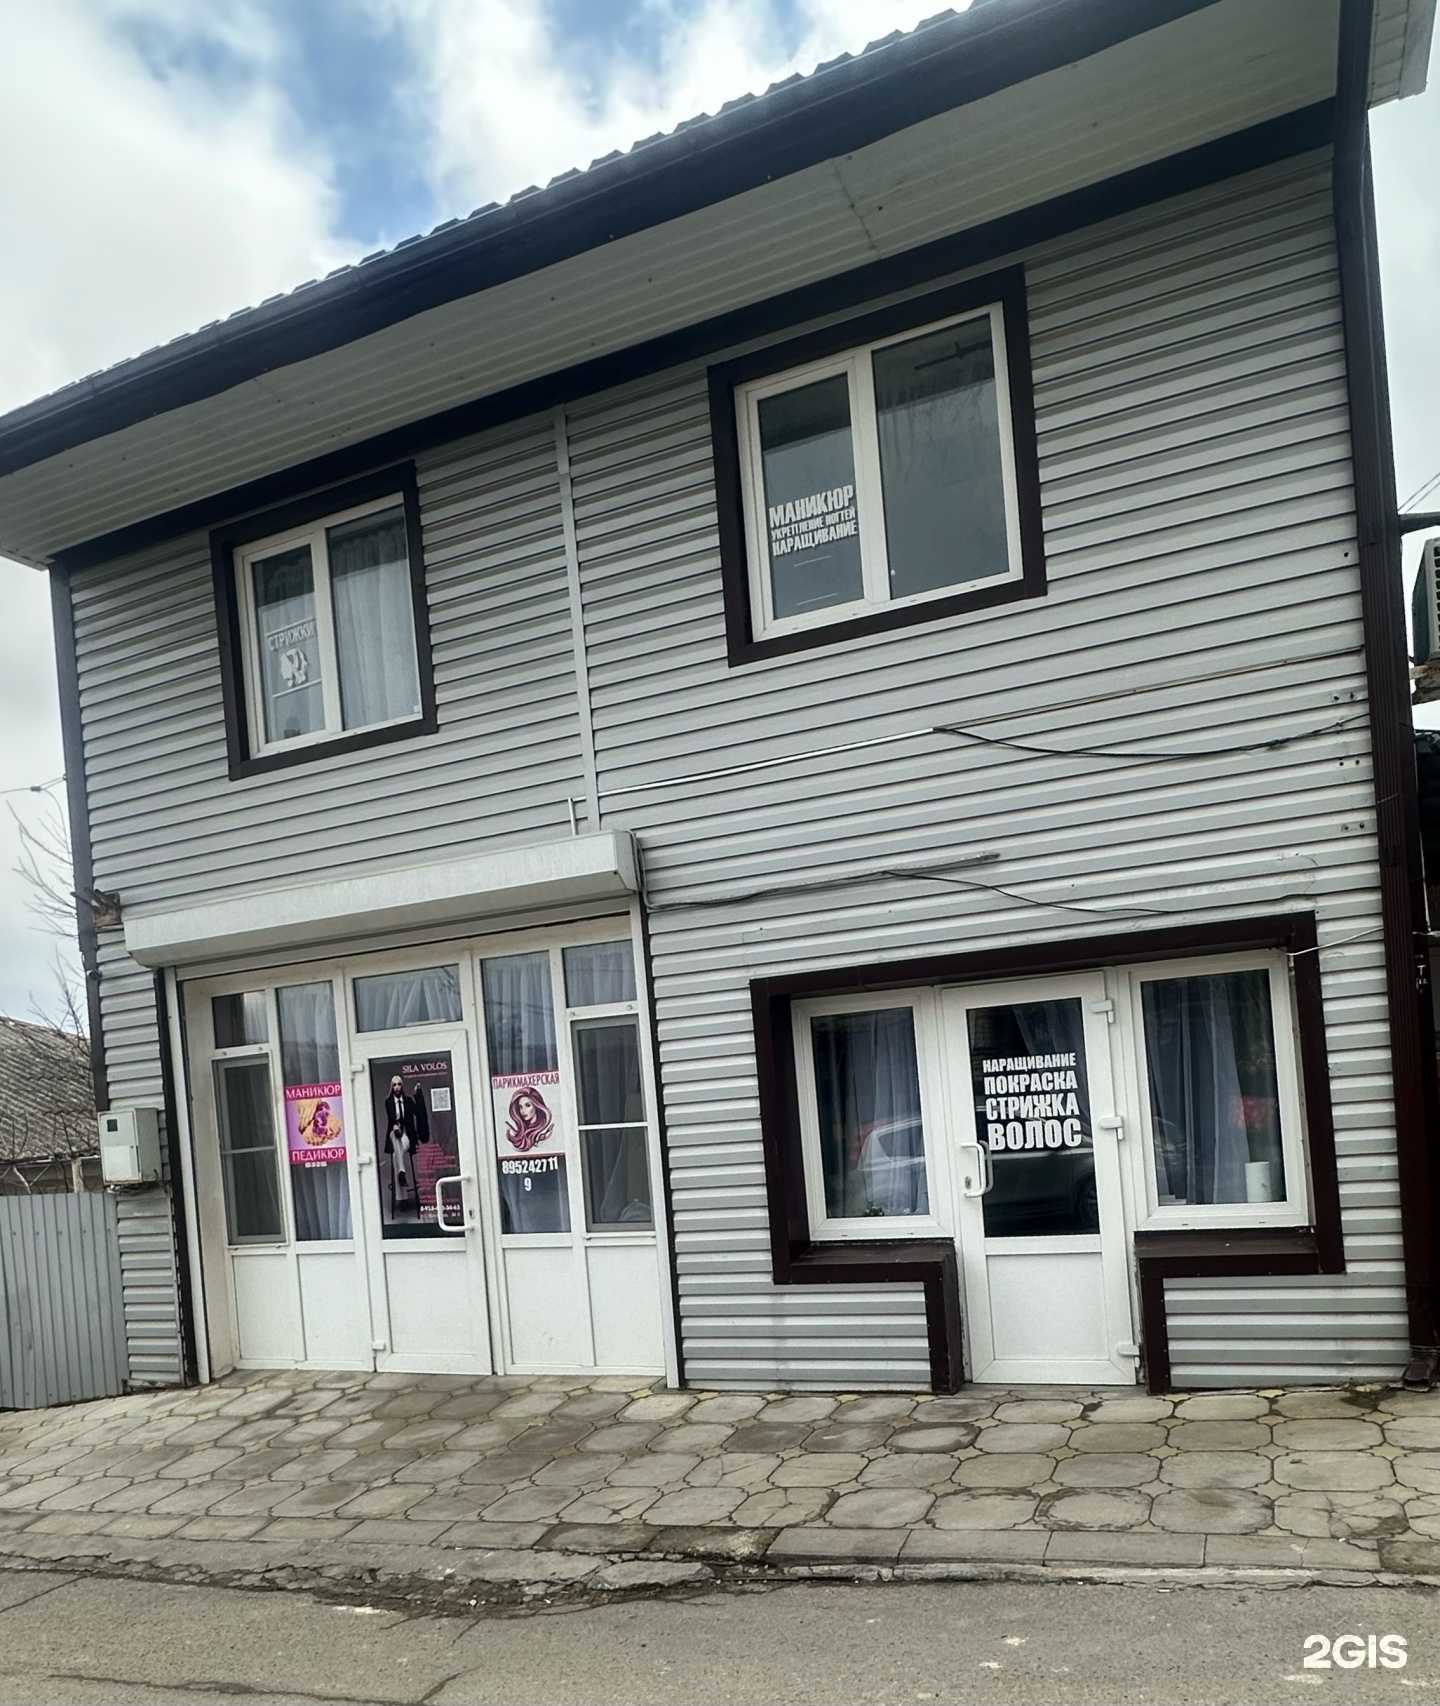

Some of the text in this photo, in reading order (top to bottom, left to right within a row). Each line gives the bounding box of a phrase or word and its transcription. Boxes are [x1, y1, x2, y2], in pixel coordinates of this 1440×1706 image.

[769, 485, 854, 528] МАНИКЮР
[771, 515, 825, 541] УКРЕПЛЕНИЕ
[772, 520, 858, 556] НАРАЩИВАНИЕ
[268, 621, 315, 652] СТРИЖКИ
[420, 1060, 448, 1071] VOLOS
[982, 1052, 1077, 1073] НАРАЩИВАНИЕ
[285, 1084, 341, 1099] МАНИКЮР
[492, 1071, 560, 1090] ПАРИКМАХЕРСКАЯ
[983, 1070, 1078, 1095] ПОКРАСКА
[985, 1092, 1080, 1121] СТРИЖКА
[987, 1118, 1082, 1151] ВОЛОС
[292, 1148, 345, 1161] ПЕДИКЮР
[501, 1156, 559, 1174] 895242711
[523, 1177, 532, 1191] 9
